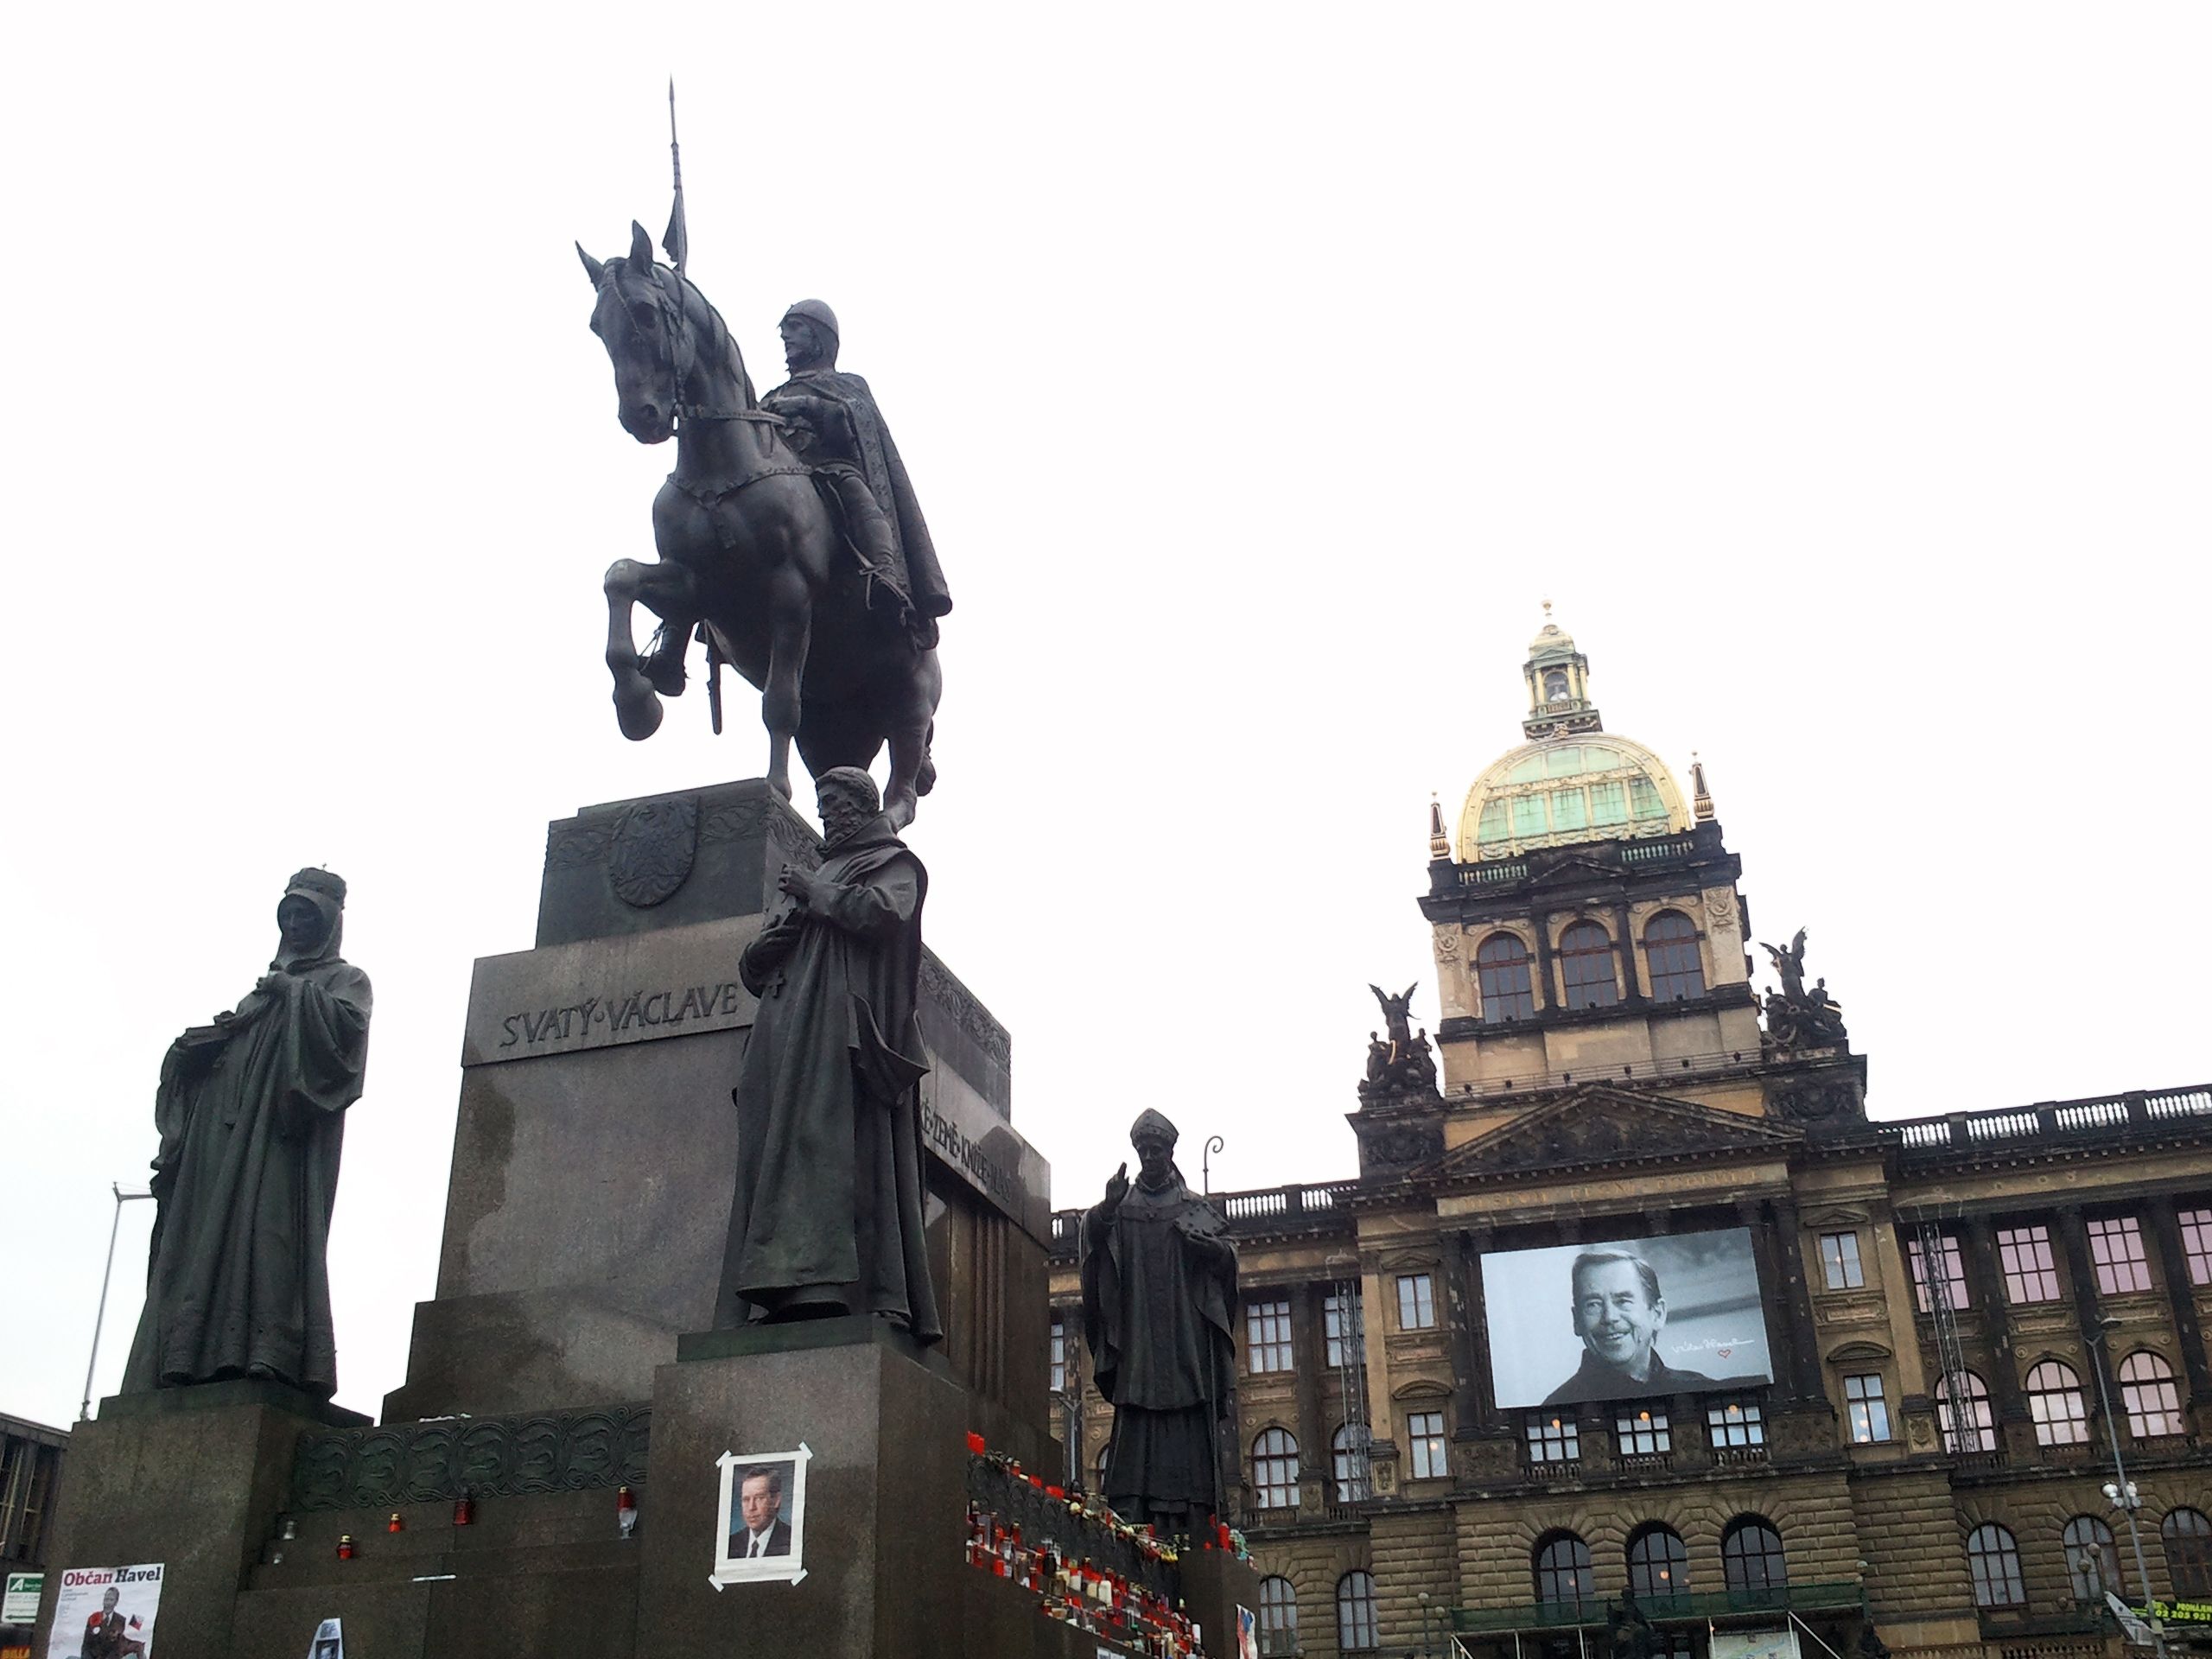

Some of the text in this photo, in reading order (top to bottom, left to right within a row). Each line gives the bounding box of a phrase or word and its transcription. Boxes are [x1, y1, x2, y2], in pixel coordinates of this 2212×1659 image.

[499, 996, 602, 1047] SVATÝ
[63, 1567, 161, 1586] Občan Havel
